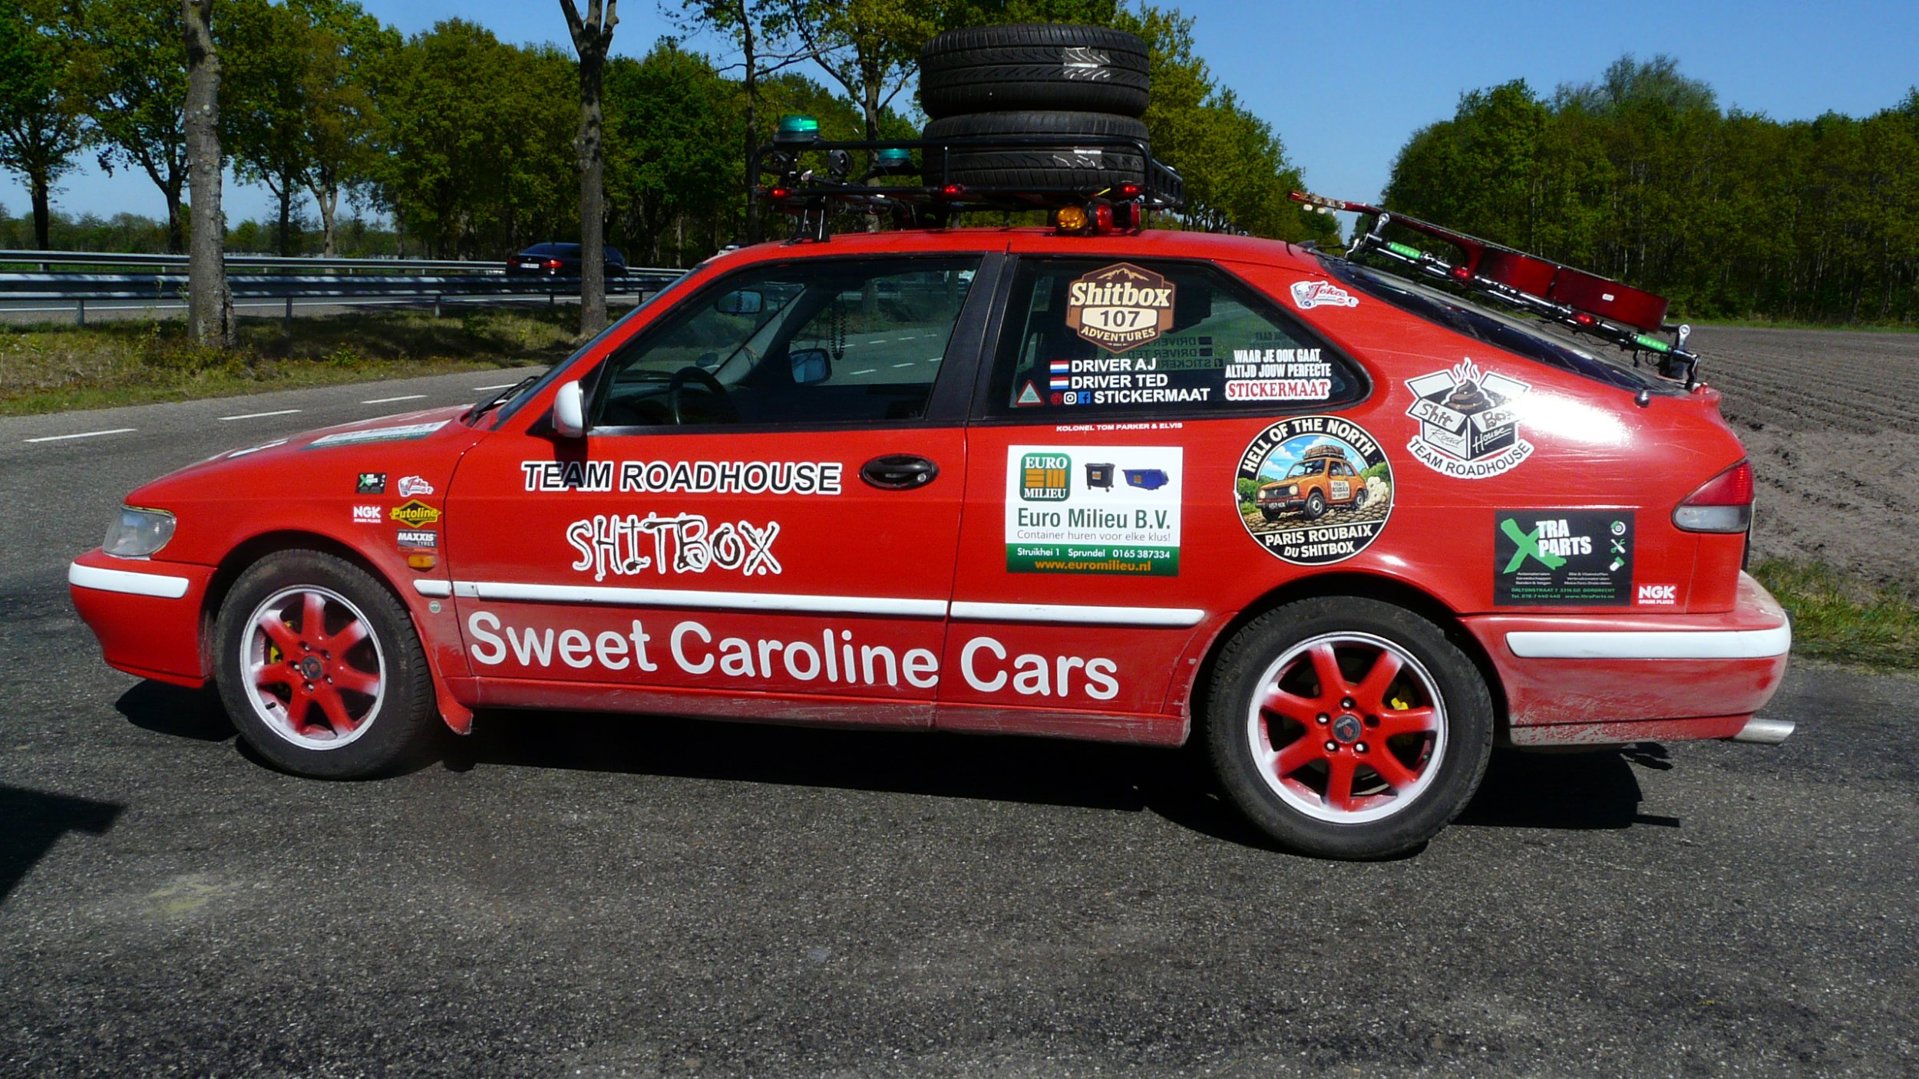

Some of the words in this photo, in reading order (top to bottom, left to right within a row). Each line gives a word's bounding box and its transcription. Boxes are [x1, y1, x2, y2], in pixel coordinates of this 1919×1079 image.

[1070, 282, 1172, 307] Shitbox
[1100, 310, 1141, 327] 107
[1081, 326, 1156, 342] ADVENTURES
[1233, 349, 1261, 363] WAAR
[1263, 349, 1275, 363] JE
[1276, 348, 1295, 363] OOK
[1296, 348, 1323, 364] GAAT,
[1071, 359, 1132, 373] DRIVER
[1135, 358, 1157, 371] AJ
[1225, 364, 1257, 378] ALTIJD
[1258, 363, 1286, 378] JOUW
[1287, 363, 1332, 377] PERFECTE
[1071, 375, 1132, 389] DRIVER
[1136, 373, 1168, 387] TED
[1094, 387, 1211, 404] STICKERMAAT
[1228, 381, 1328, 398] STICKERMAAT
[1420, 402, 1453, 427] Shit
[1056, 424, 1095, 432] KOLONEL
[1242, 441, 1272, 473] HELL
[1269, 423, 1288, 442] OF
[1291, 418, 1323, 433] THE
[1327, 420, 1377, 457] NORTH
[1024, 457, 1068, 469] EURO
[1409, 439, 1443, 469] TEAM
[1445, 444, 1530, 476] ROADHOUSE
[522, 461, 613, 492] TEAM
[621, 462, 842, 494] ROADHOUSE
[1023, 488, 1067, 499] MILIEU
[353, 506, 381, 518] NGK
[392, 508, 438, 518] Putoline
[1018, 508, 1061, 528] Euro
[1068, 508, 1128, 529] Milieu
[1135, 509, 1171, 530] B.V.
[398, 533, 434, 541] MAXXIS
[1017, 530, 1064, 540] Container
[1067, 530, 1097, 541] huren
[1099, 533, 1122, 541] voor
[1125, 531, 1146, 542] elke
[1148, 532, 1171, 542] klus!
[1265, 531, 1305, 547] PARIS
[1309, 525, 1373, 543] ROUBAIX
[566, 512, 782, 581] SHITBOX
[1055, 548, 1060, 557] 1
[1068, 548, 1106, 559] Sprundel
[1112, 549, 1136, 558] 0165
[1137, 549, 1171, 559] 387334
[1284, 547, 1300, 558] DU
[1301, 541, 1355, 558] SHITBOX
[1538, 536, 1592, 557] PARTS
[1035, 560, 1151, 571] www.euromilieu.nl
[1638, 586, 1676, 599] NGK
[468, 610, 658, 673] Sweet
[670, 620, 939, 688] Caroline
[961, 636, 1119, 701] Cars
